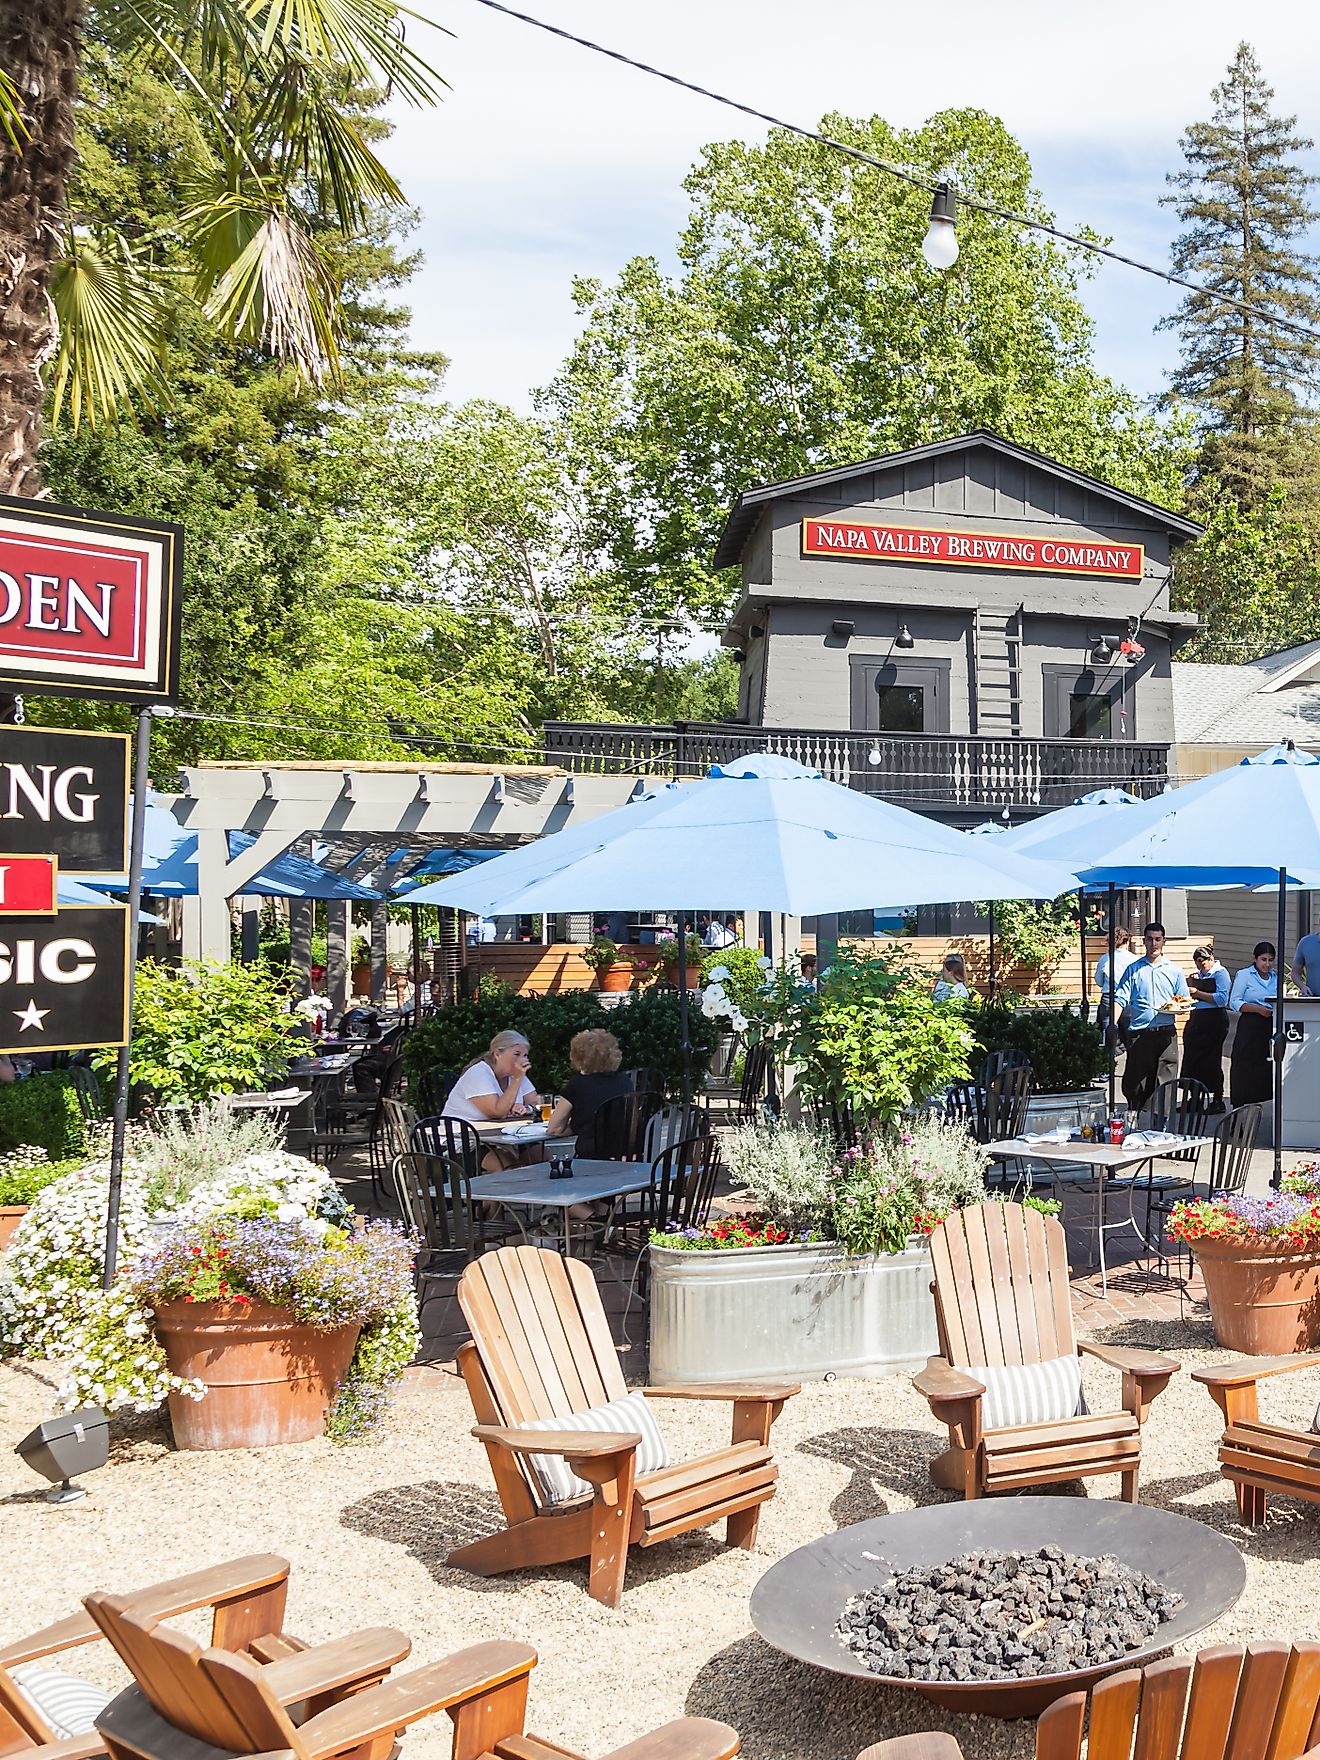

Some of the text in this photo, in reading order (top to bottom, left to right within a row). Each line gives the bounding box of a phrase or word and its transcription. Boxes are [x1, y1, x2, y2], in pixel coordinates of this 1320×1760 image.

[816, 525, 1131, 570] NAPA VALLEY BREWING COMPANY
[0, 762, 101, 823] NG
